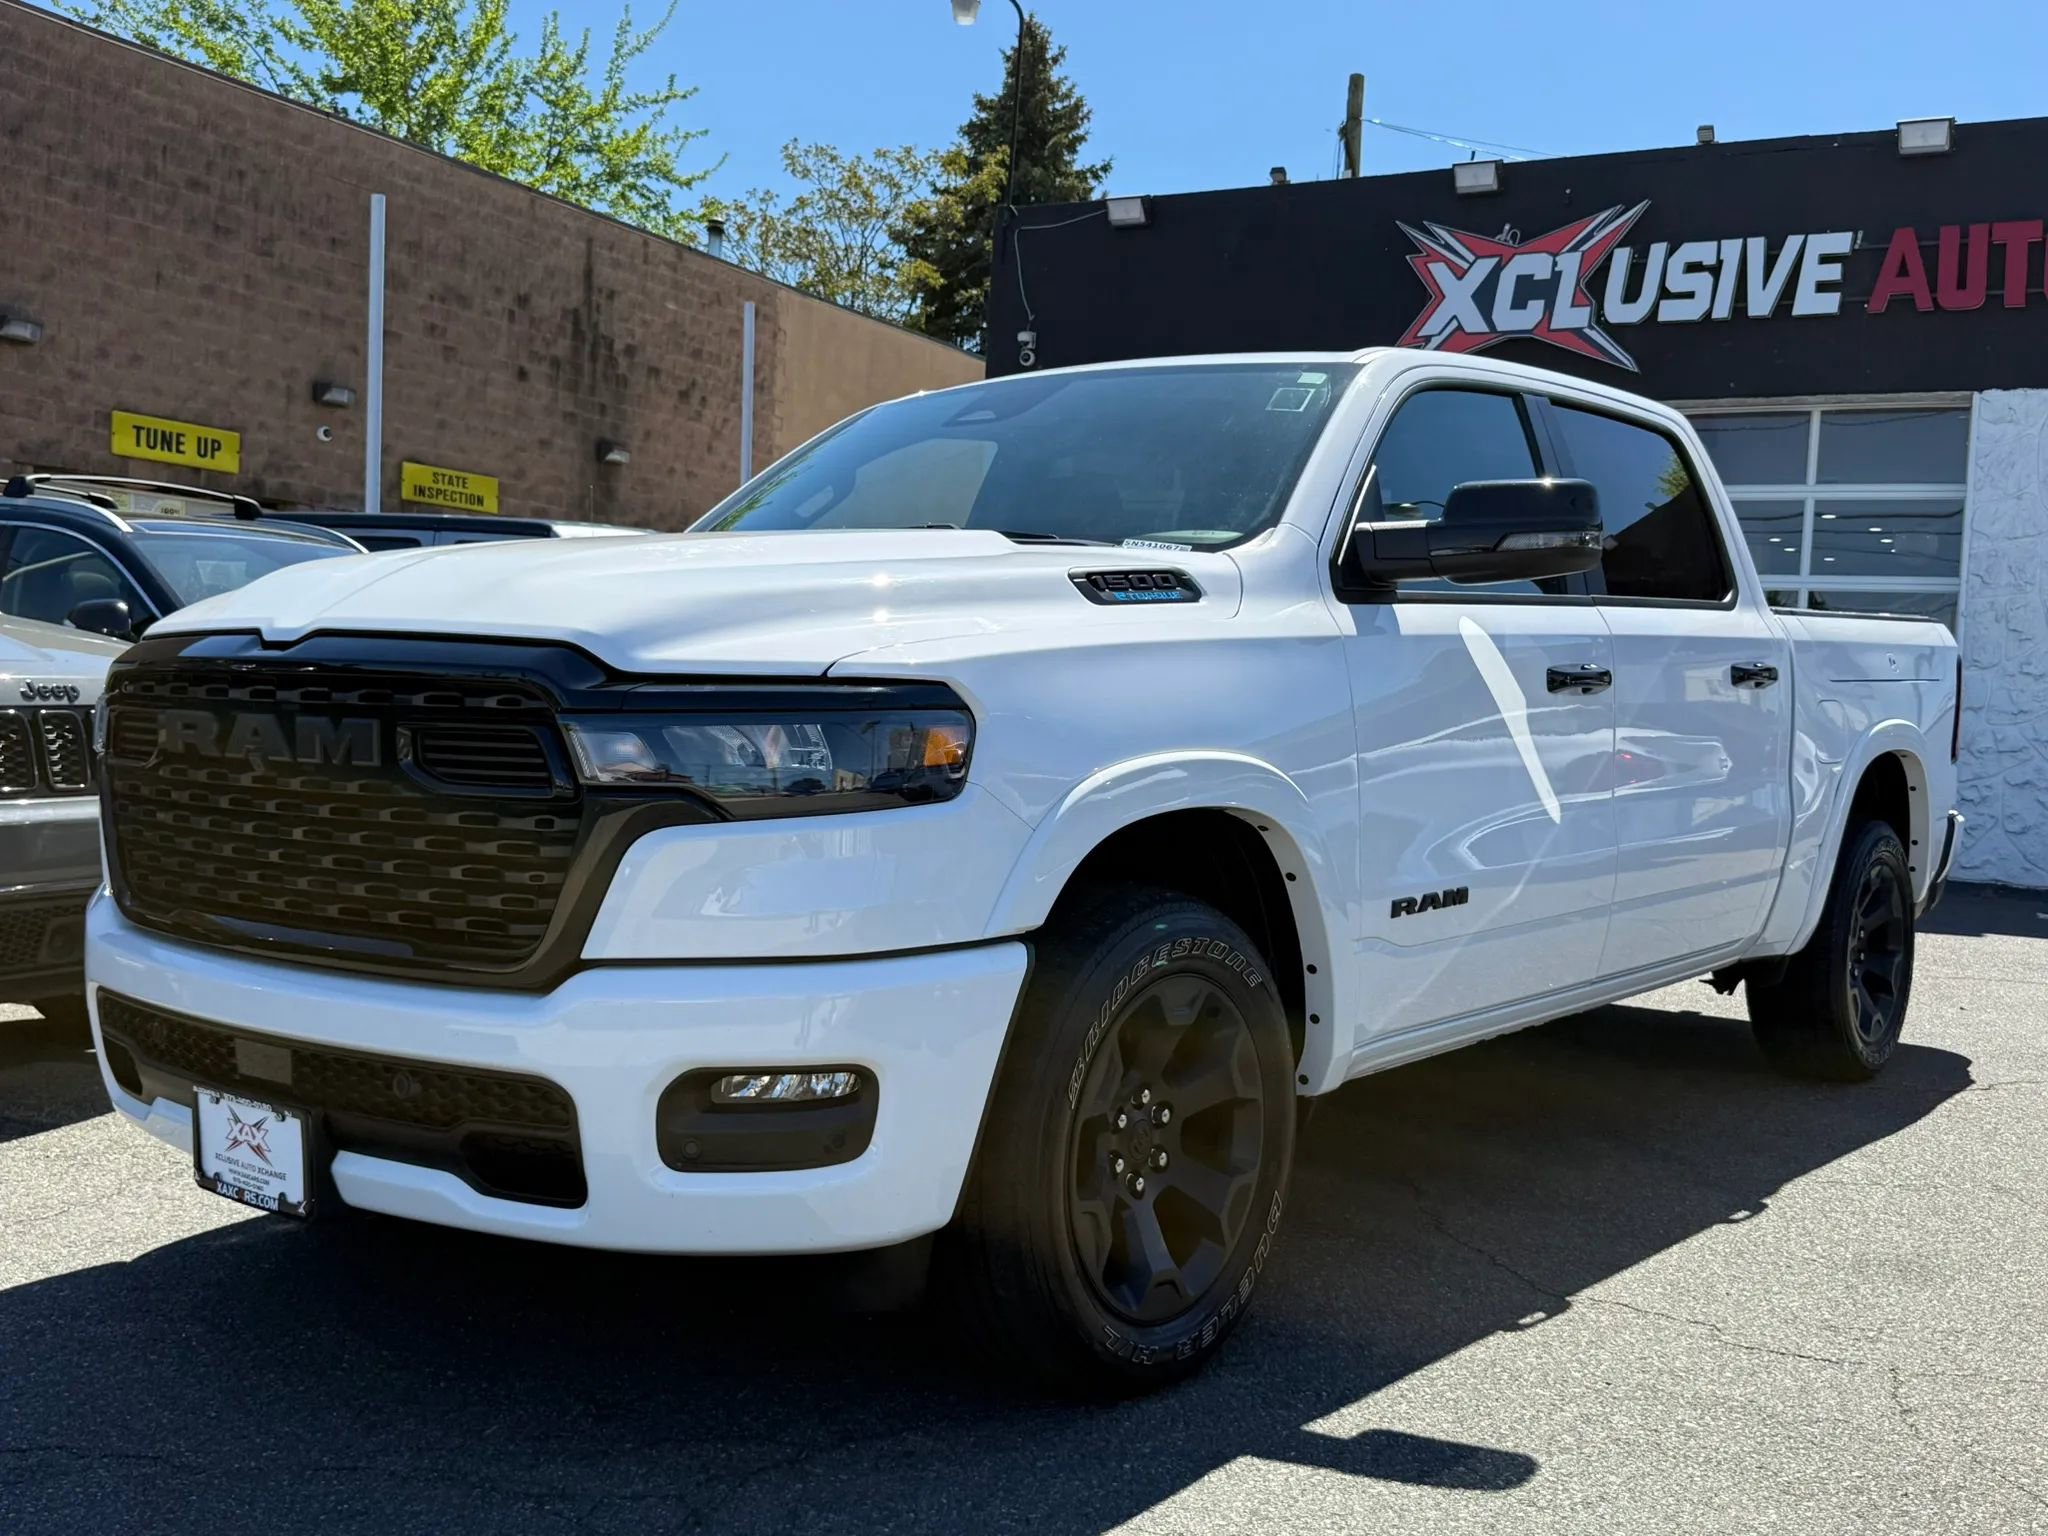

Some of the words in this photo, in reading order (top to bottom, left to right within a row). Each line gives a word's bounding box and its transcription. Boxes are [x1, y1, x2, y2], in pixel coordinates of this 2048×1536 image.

[1417, 231, 1854, 337] XCLUSIVE
[1866, 219, 2048, 312] AUT
[132, 425, 186, 455] TUNE
[197, 436, 222, 459] UP
[413, 484, 485, 507] INSPECTION
[432, 472, 469, 489] STATE
[1091, 574, 1178, 590] 1500
[20, 679, 80, 704] Jeep
[158, 708, 381, 767] RAM
[1390, 886, 1469, 919] RAM
[1068, 937, 1263, 1110] BRIDGESTONE
[226, 1117, 272, 1152] XAX
[241, 1158, 257, 1172] AUTO
[257, 1166, 287, 1181] XCHANGE
[216, 1182, 279, 1211] XAXCRS.COM
[1176, 1189, 1282, 1361] DUELER
